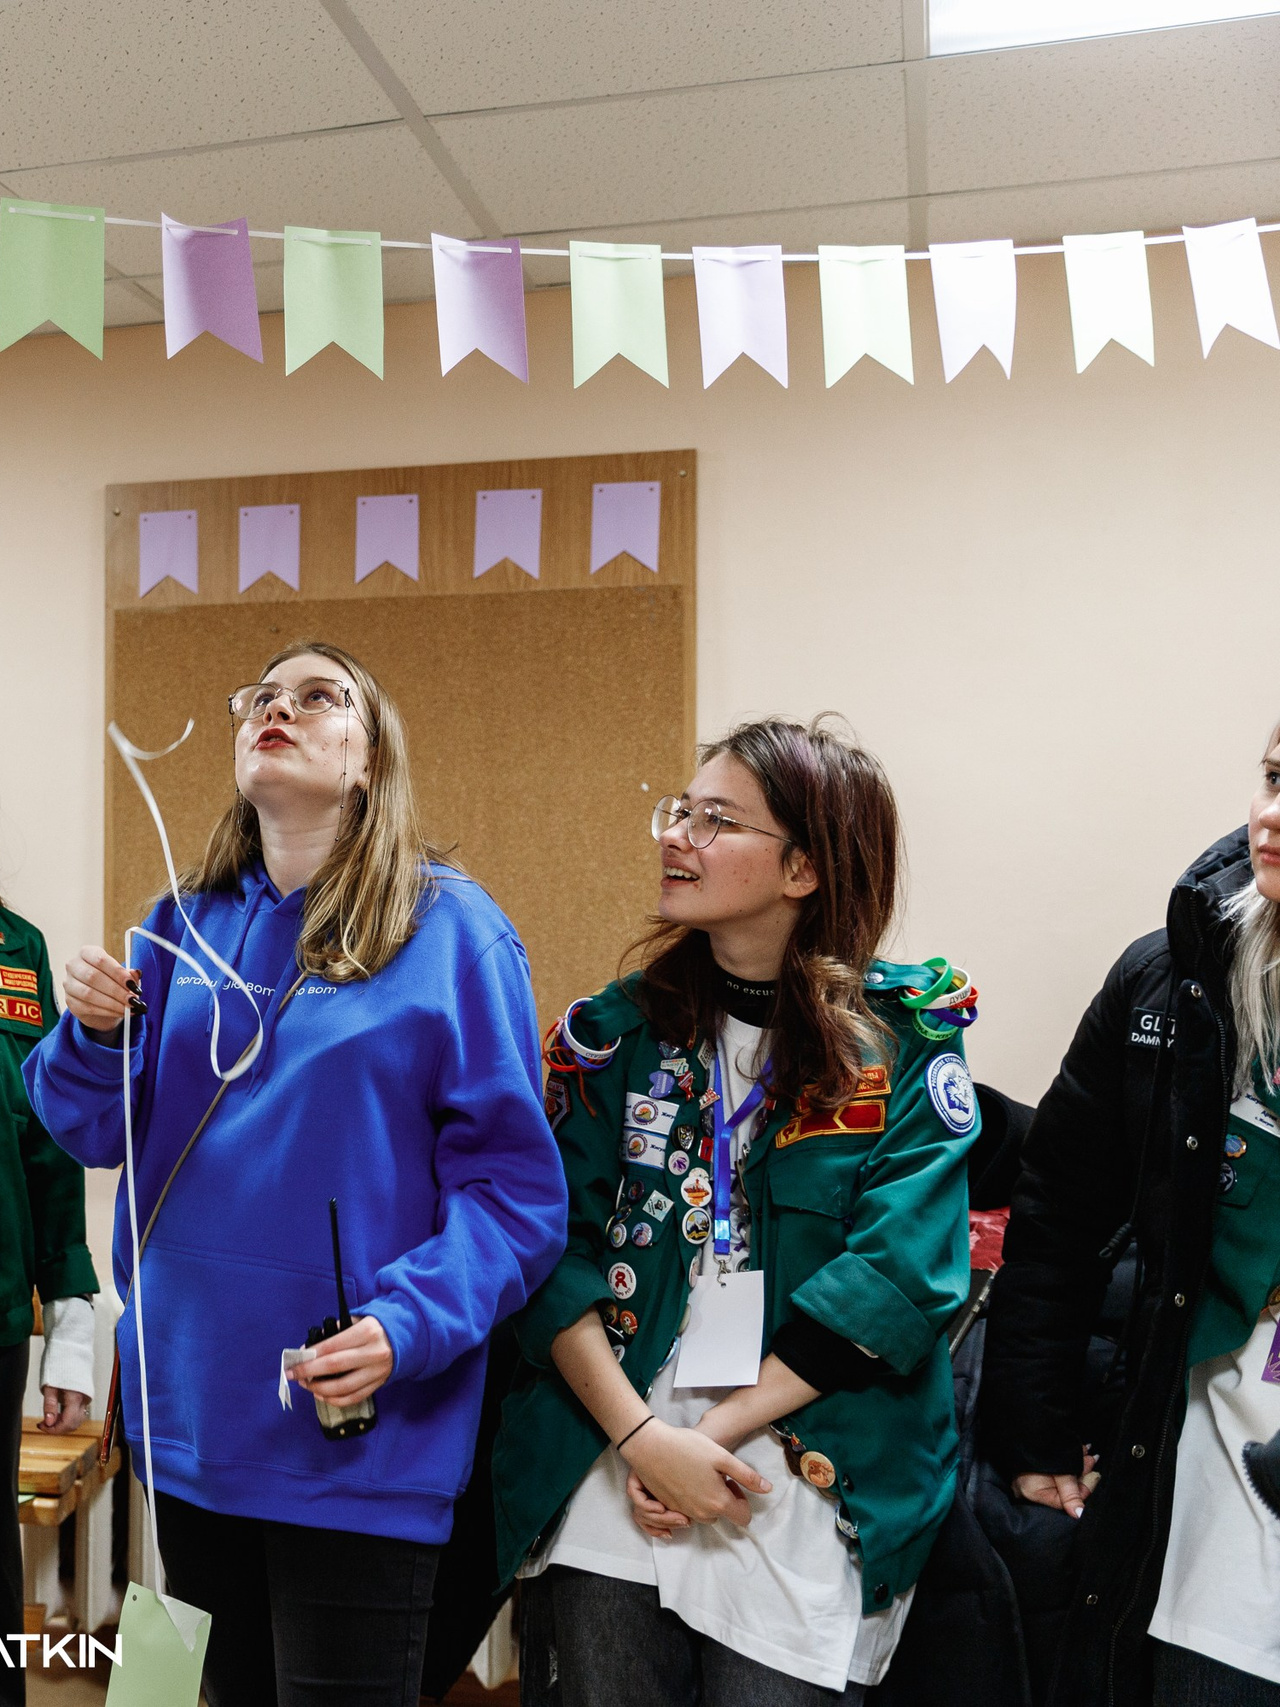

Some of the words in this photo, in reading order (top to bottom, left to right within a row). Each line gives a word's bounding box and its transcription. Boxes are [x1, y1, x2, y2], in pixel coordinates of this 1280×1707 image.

[307, 985, 337, 995] вот
[726, 980, 740, 990] no
[743, 987, 775, 996] excus
[15, 1002, 42, 1020] ЛС
